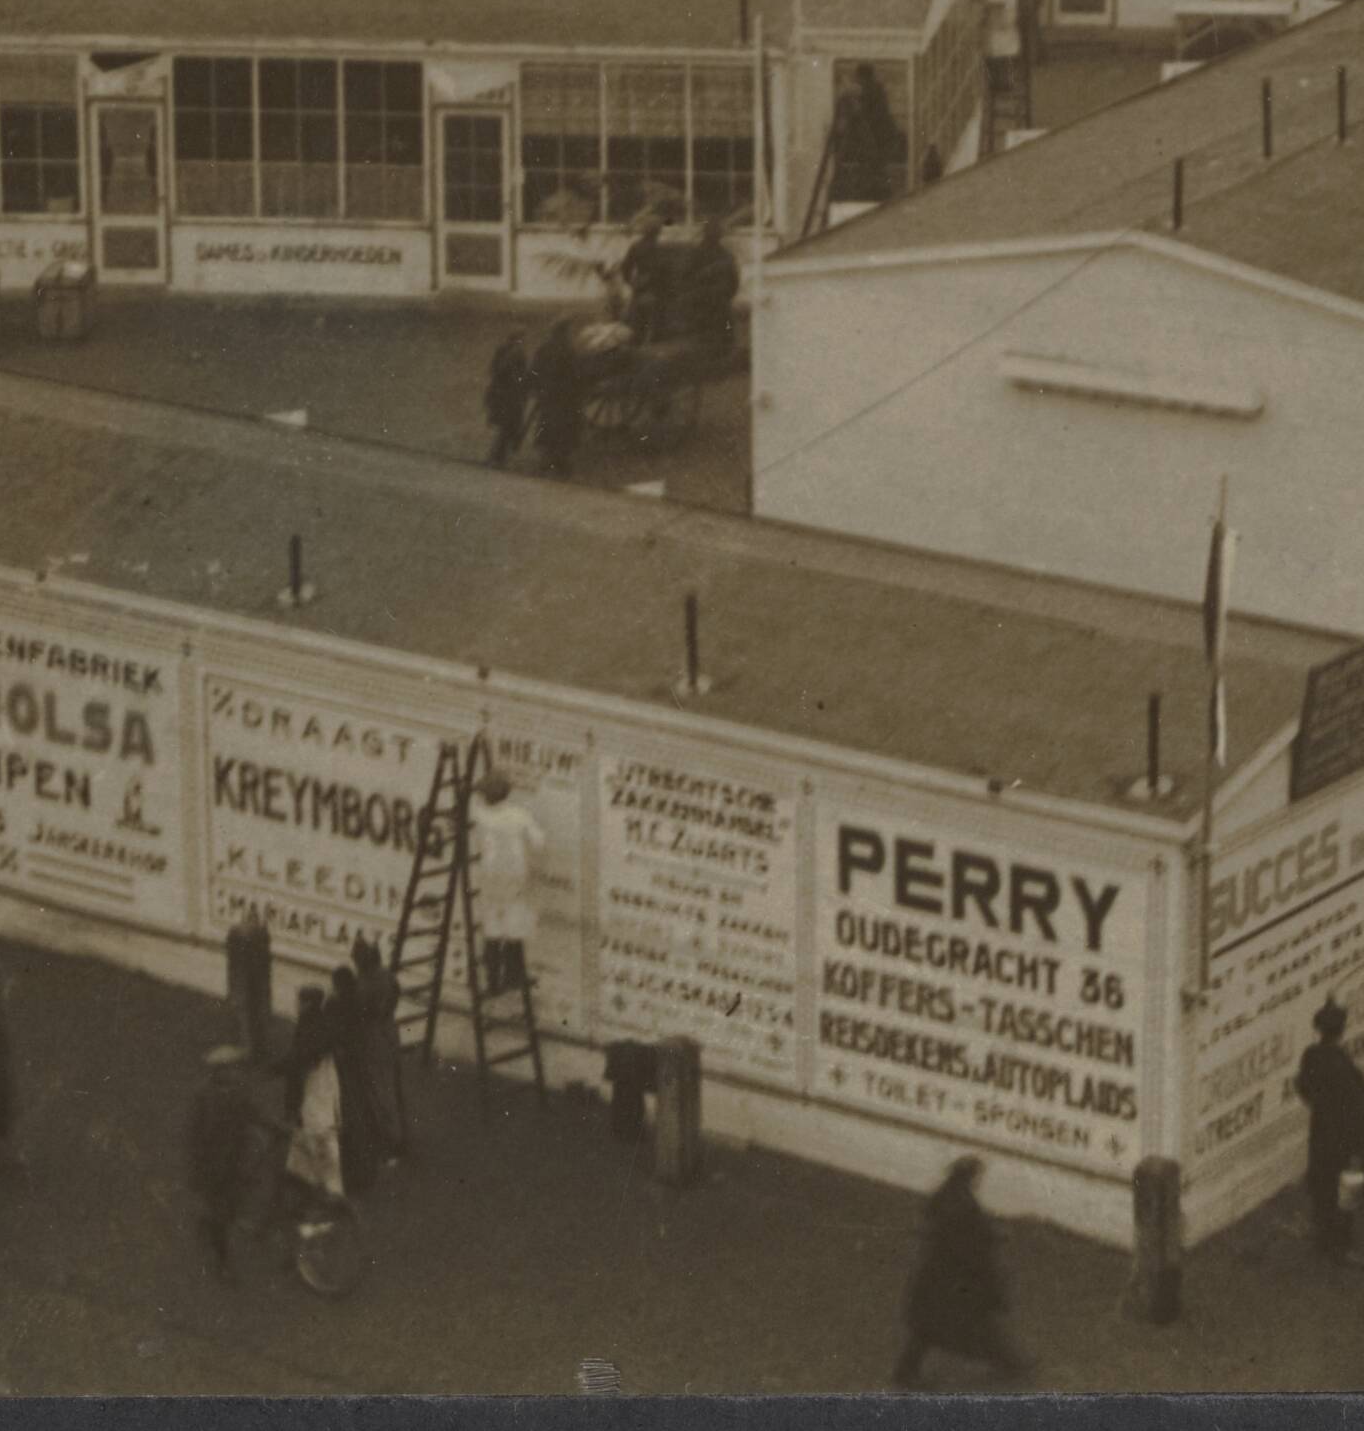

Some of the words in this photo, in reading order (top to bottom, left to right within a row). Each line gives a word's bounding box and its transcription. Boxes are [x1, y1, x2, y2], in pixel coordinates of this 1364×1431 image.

[240, 698, 414, 766] DRAAGT
[837, 822, 1121, 954] PERRY
[1208, 821, 1341, 943] SUCCES
[835, 908, 1061, 997] OUDEGRACHT
[1078, 966, 1126, 1012] 36
